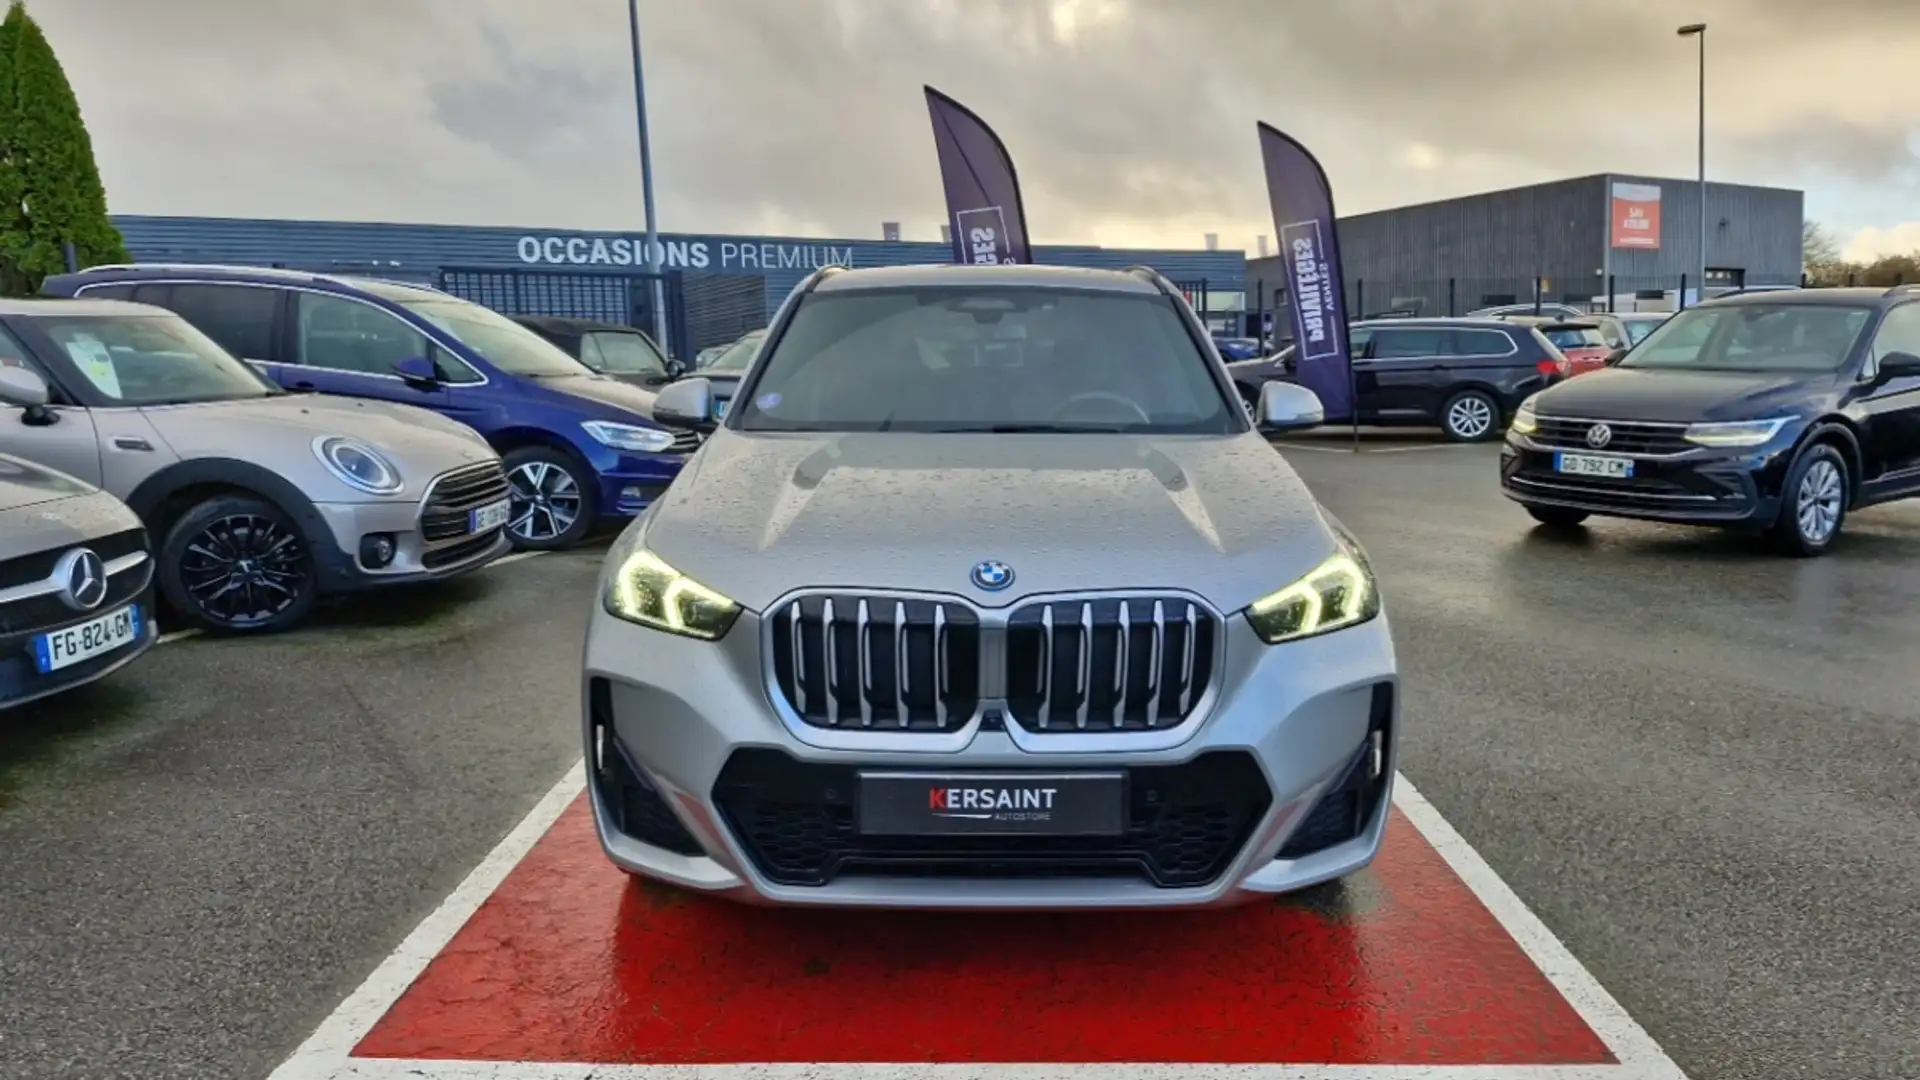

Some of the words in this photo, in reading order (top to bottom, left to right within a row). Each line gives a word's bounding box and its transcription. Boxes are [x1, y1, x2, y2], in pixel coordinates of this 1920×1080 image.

[518, 236, 709, 268] OCCASIONS
[721, 243, 853, 269] PREMIUM
[930, 788, 1057, 809] KERSAINT
[994, 813, 1051, 821] AUTOSTORE
